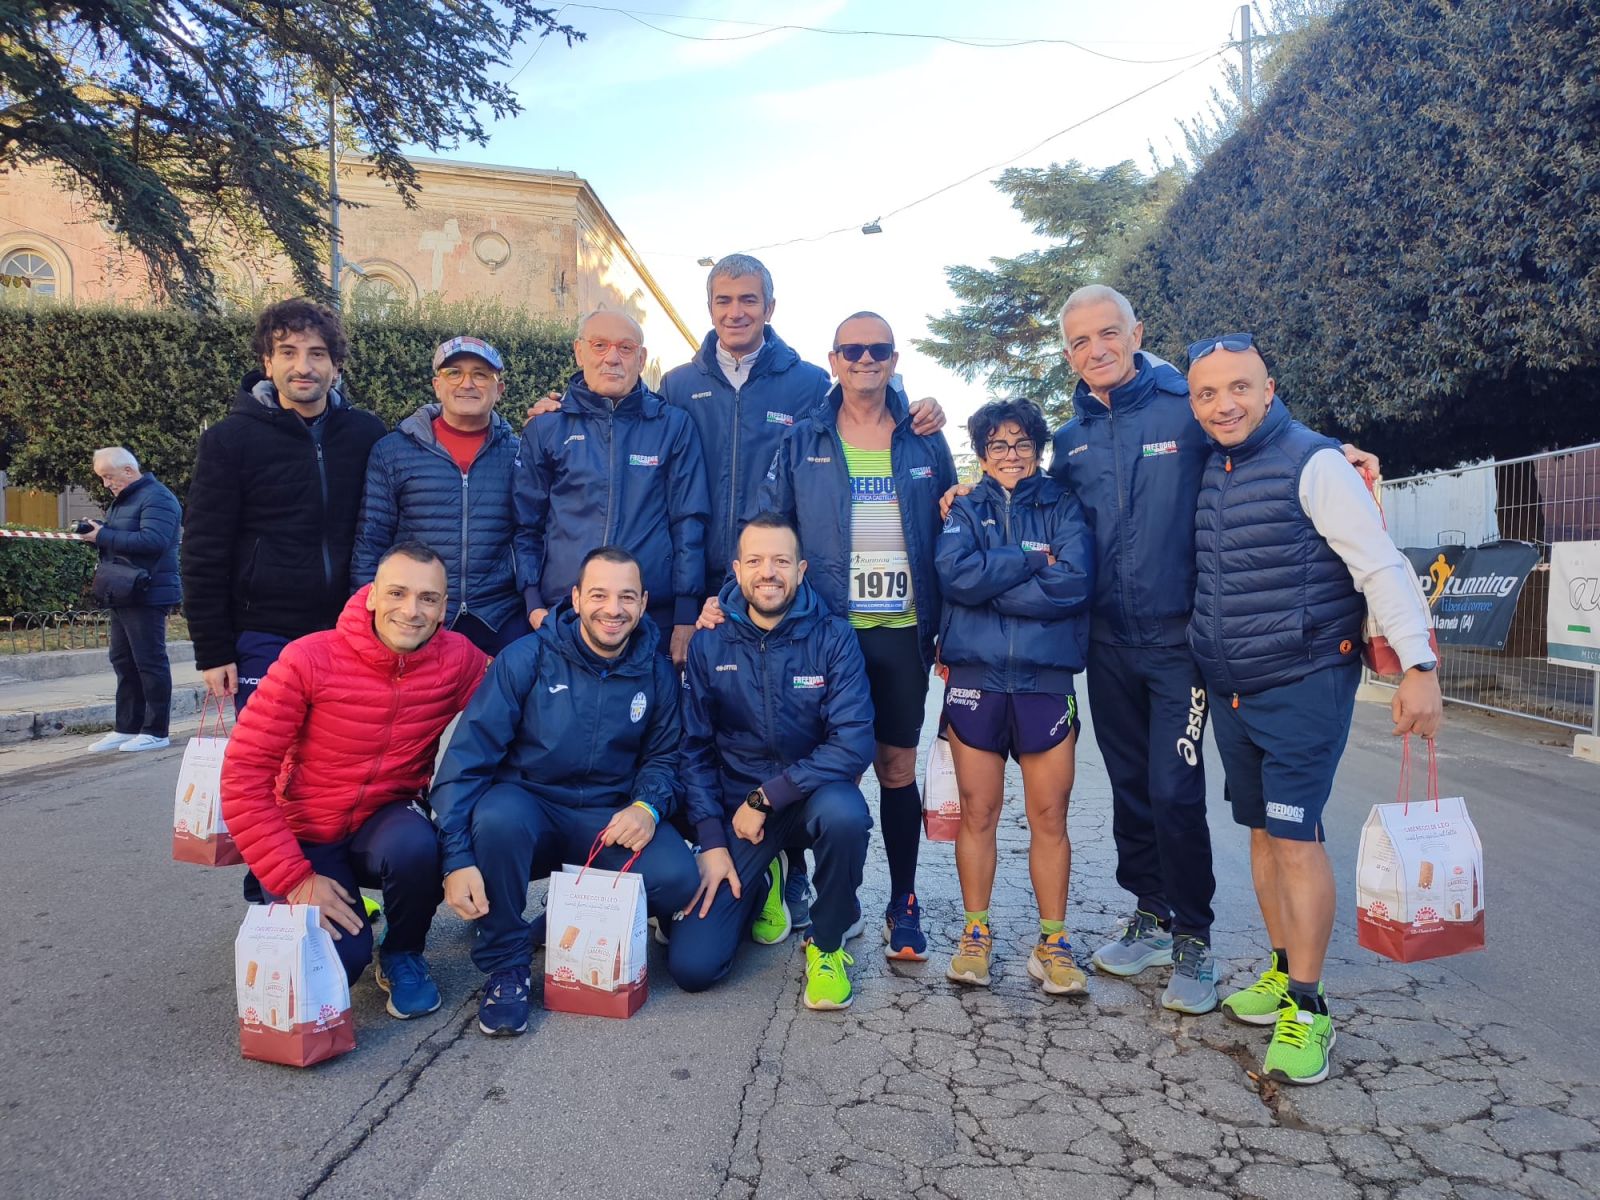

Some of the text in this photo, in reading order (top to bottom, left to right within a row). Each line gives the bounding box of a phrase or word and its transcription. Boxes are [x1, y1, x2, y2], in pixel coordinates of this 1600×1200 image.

[1142, 441, 1177, 453] FREEDOGS
[854, 571, 908, 598] 1979
[1185, 686, 1207, 741] asics
[1266, 801, 1305, 819] FREEDOGS
